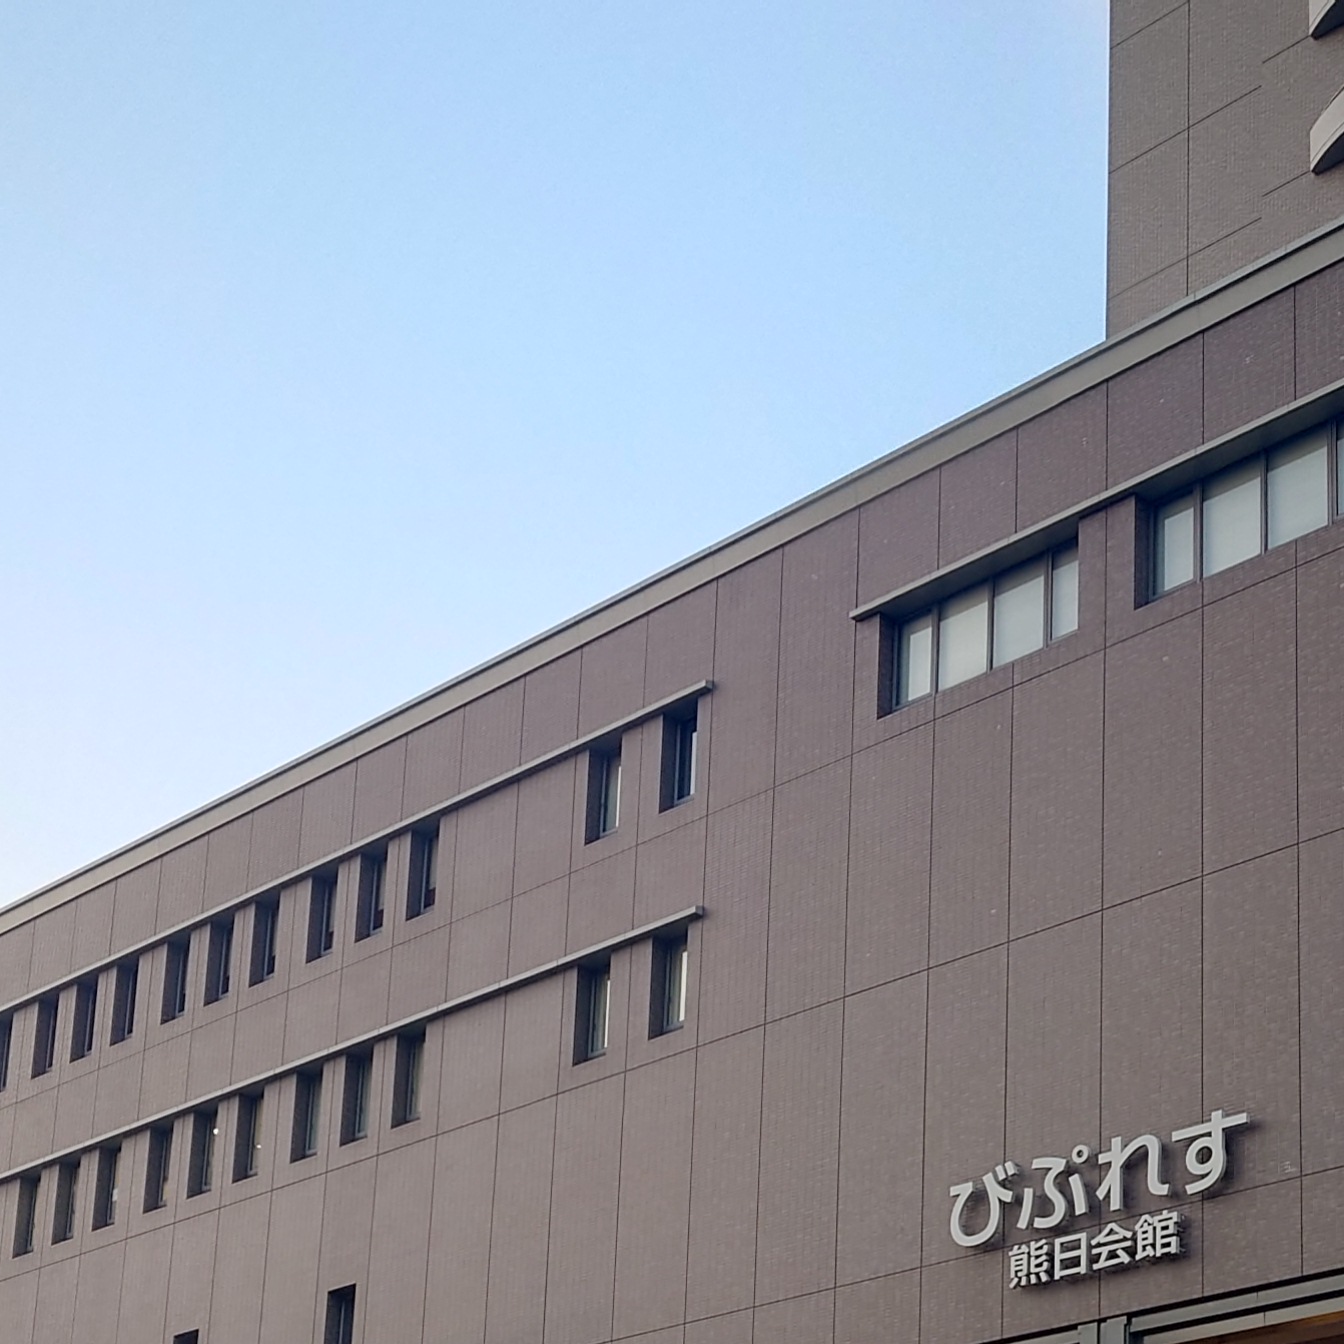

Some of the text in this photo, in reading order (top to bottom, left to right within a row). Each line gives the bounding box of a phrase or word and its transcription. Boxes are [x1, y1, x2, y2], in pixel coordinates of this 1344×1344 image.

[949, 1109, 1249, 1247] びぷれす
[1008, 1210, 1180, 1288] 熊日会館
